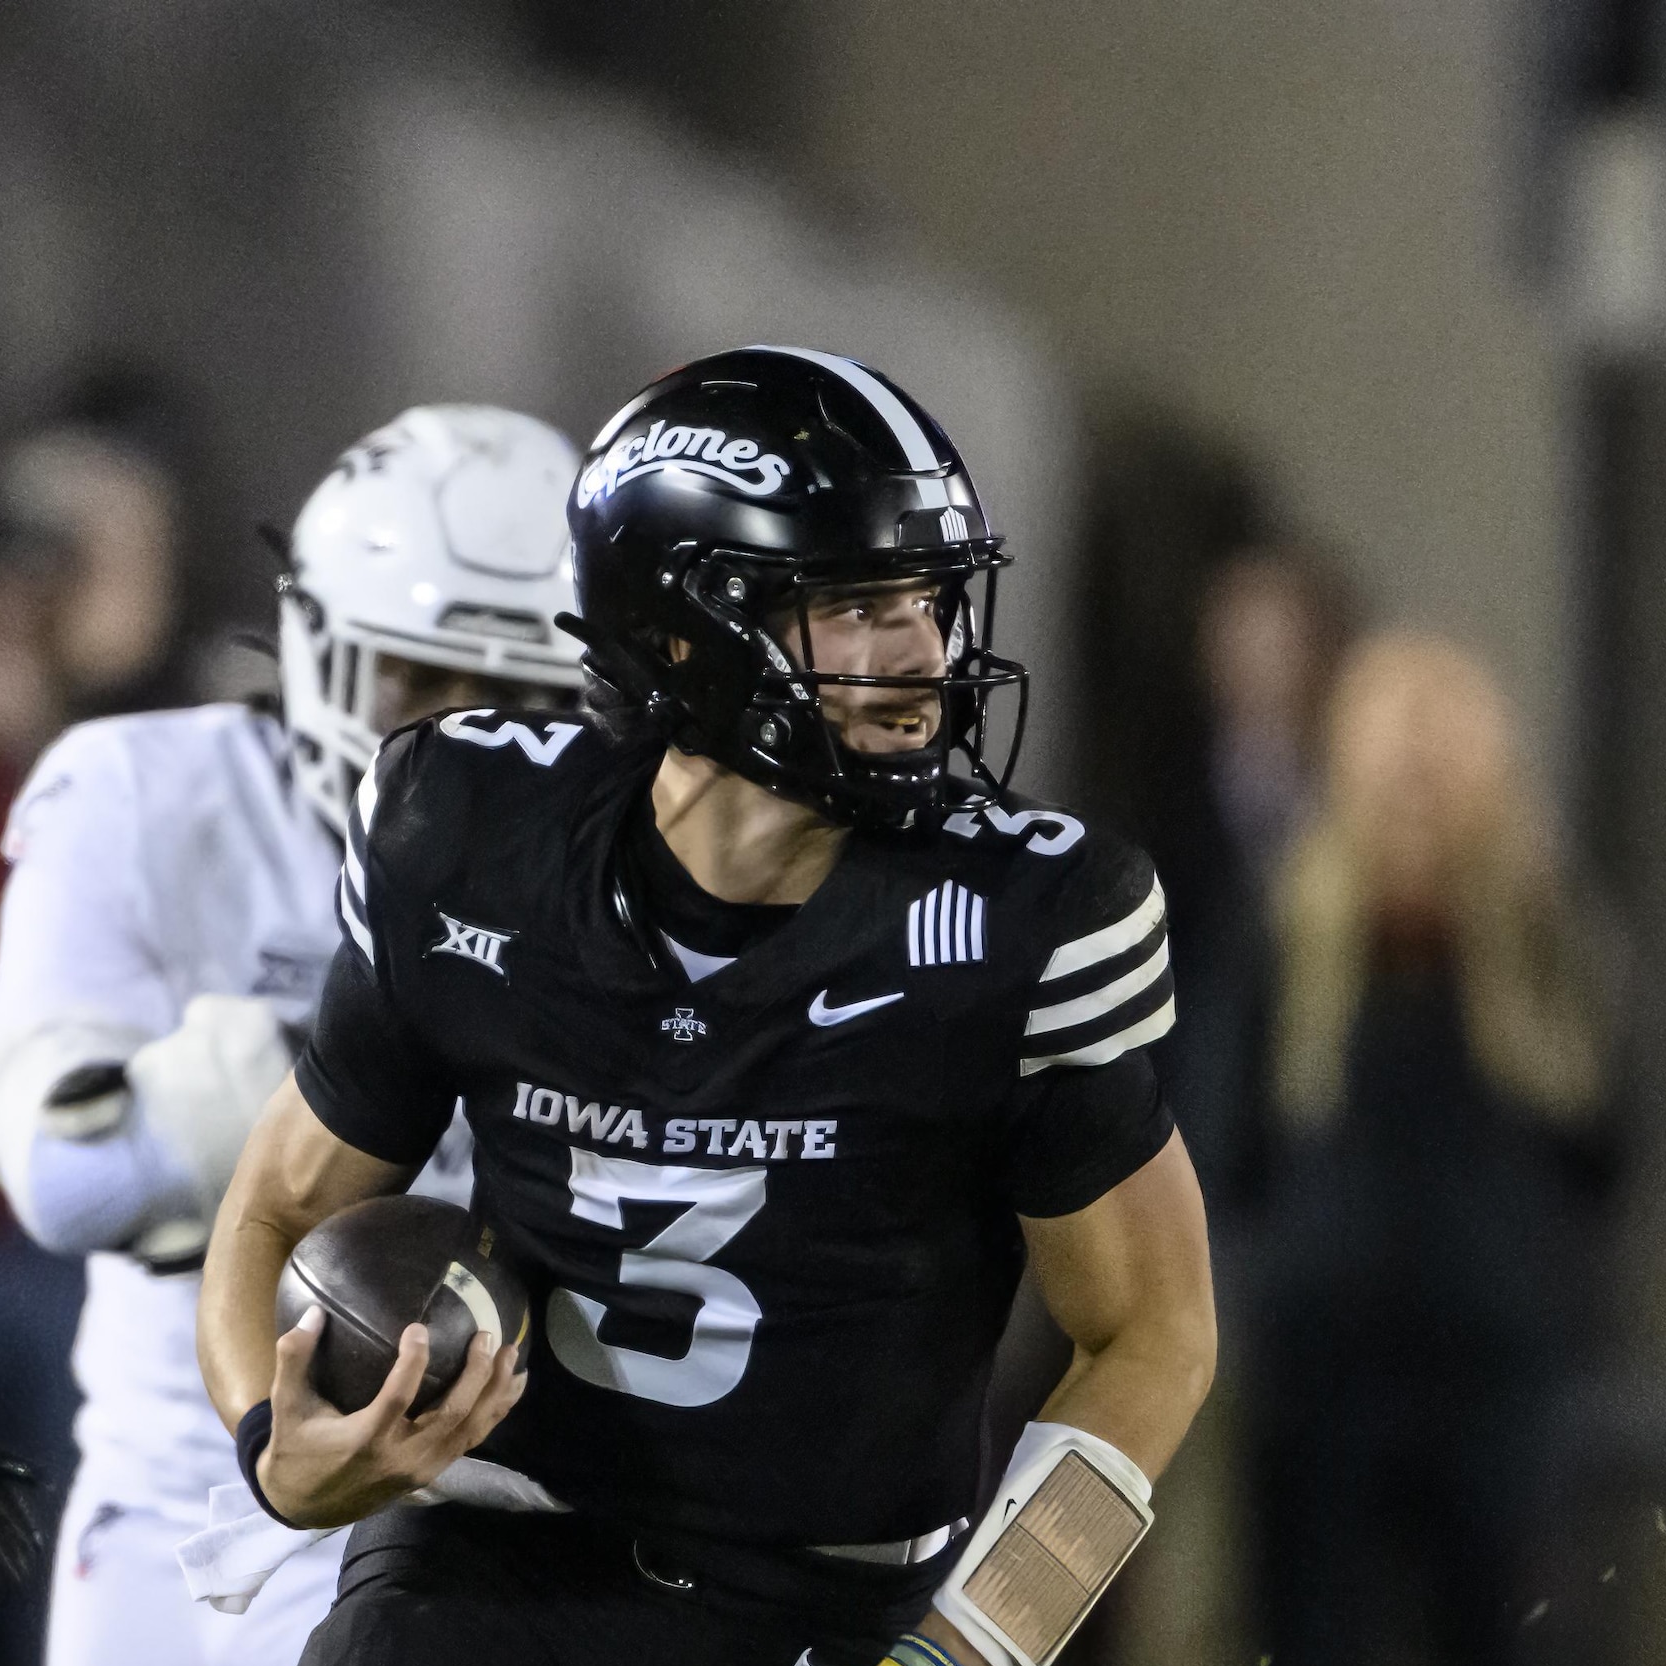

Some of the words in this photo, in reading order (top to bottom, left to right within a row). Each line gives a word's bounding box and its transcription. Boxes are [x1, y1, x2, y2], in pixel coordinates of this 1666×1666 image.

[439, 708, 584, 767] 3
[433, 911, 511, 975] XII
[512, 1082, 649, 1150] IOWA
[662, 1118, 838, 1160] STATE
[546, 1147, 767, 1407] 3
